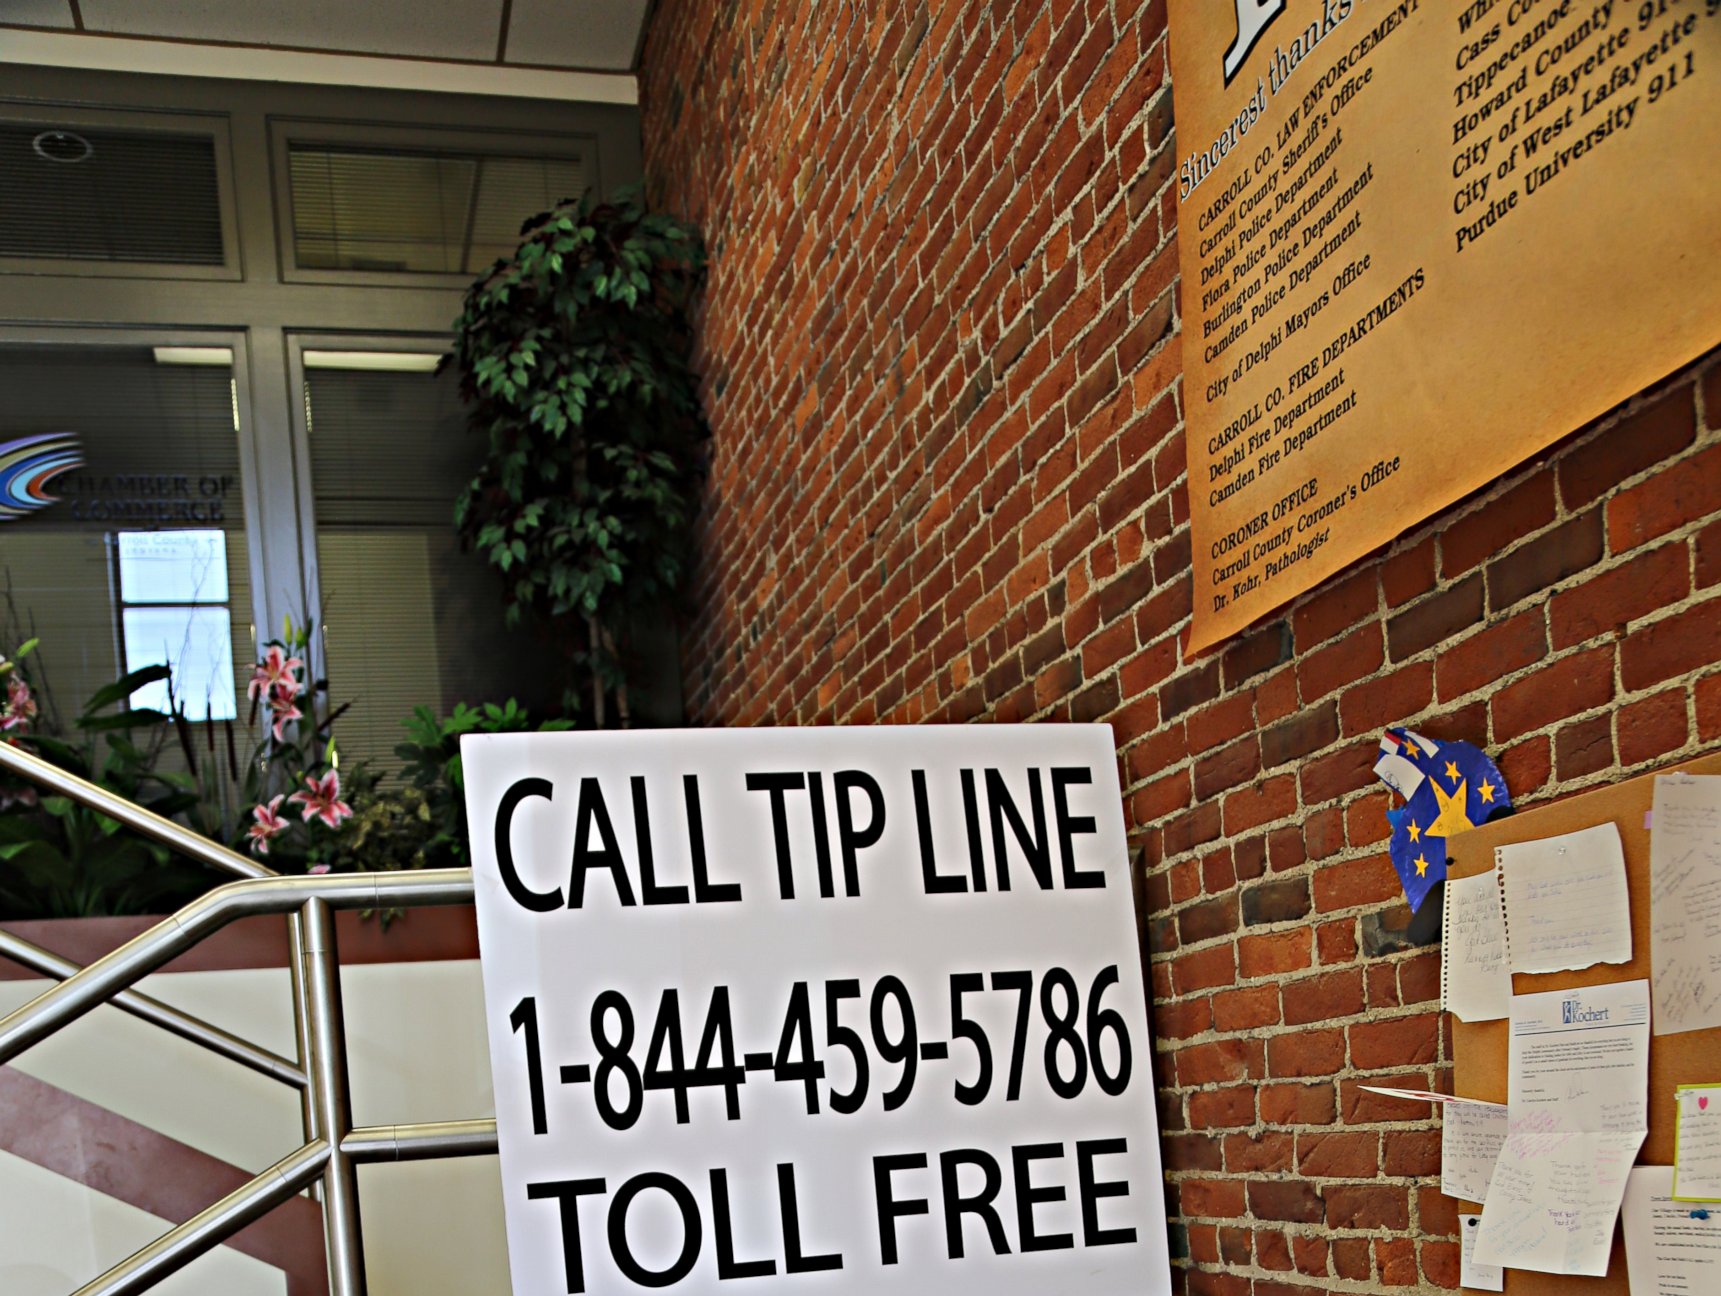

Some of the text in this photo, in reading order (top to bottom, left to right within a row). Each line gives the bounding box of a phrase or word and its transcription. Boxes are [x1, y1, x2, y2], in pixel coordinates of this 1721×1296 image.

[1180, 77, 1266, 203] Sincerest
[1268, 0, 1353, 96] thanks
[1198, 0, 1419, 232] CARROLL CO. LAW ENFORCEMENT
[1452, 136, 1492, 178] City
[1498, 107, 1519, 143] of
[1523, 26, 1630, 124] Lafayette
[1453, 0, 1571, 107] Tippecanoe
[1453, 0, 1613, 145] Howard County
[1453, 12, 1697, 215] City of West Lafayette
[1456, 23, 1500, 71] Cass
[1199, 66, 1373, 258] Carroll County Sheriff's Office
[1201, 126, 1343, 286] Delphi Police Department
[1455, 51, 1695, 253] Purdue University 911
[1202, 166, 1339, 312] Flora Police Department
[1203, 161, 1374, 339] Burlington Police Department
[1204, 209, 1362, 364] Camden Police Department
[1206, 253, 1371, 403] City of Delphi Mayors Office
[1208, 267, 1425, 455] CARROLL CO. FIRE DEPARTMENTS
[58, 473, 234, 498] CHAMBER OF
[1209, 367, 1346, 483] Delphi Fire Department
[1209, 389, 1358, 508] Camden Fire Department
[71, 499, 225, 521] COMMERCE
[1211, 478, 1319, 560] CORONER OFFICE
[1212, 455, 1401, 586] Carroll County Coroner's Office
[1213, 527, 1330, 613] Dr. Kohr, Pathologist
[494, 766, 1107, 913] CALL TIP LINE
[509, 963, 1133, 1136] 1-844-459-5786
[1572, 1006, 1609, 1023] Kochert
[526, 1137, 1138, 1295] TOLL FREE
